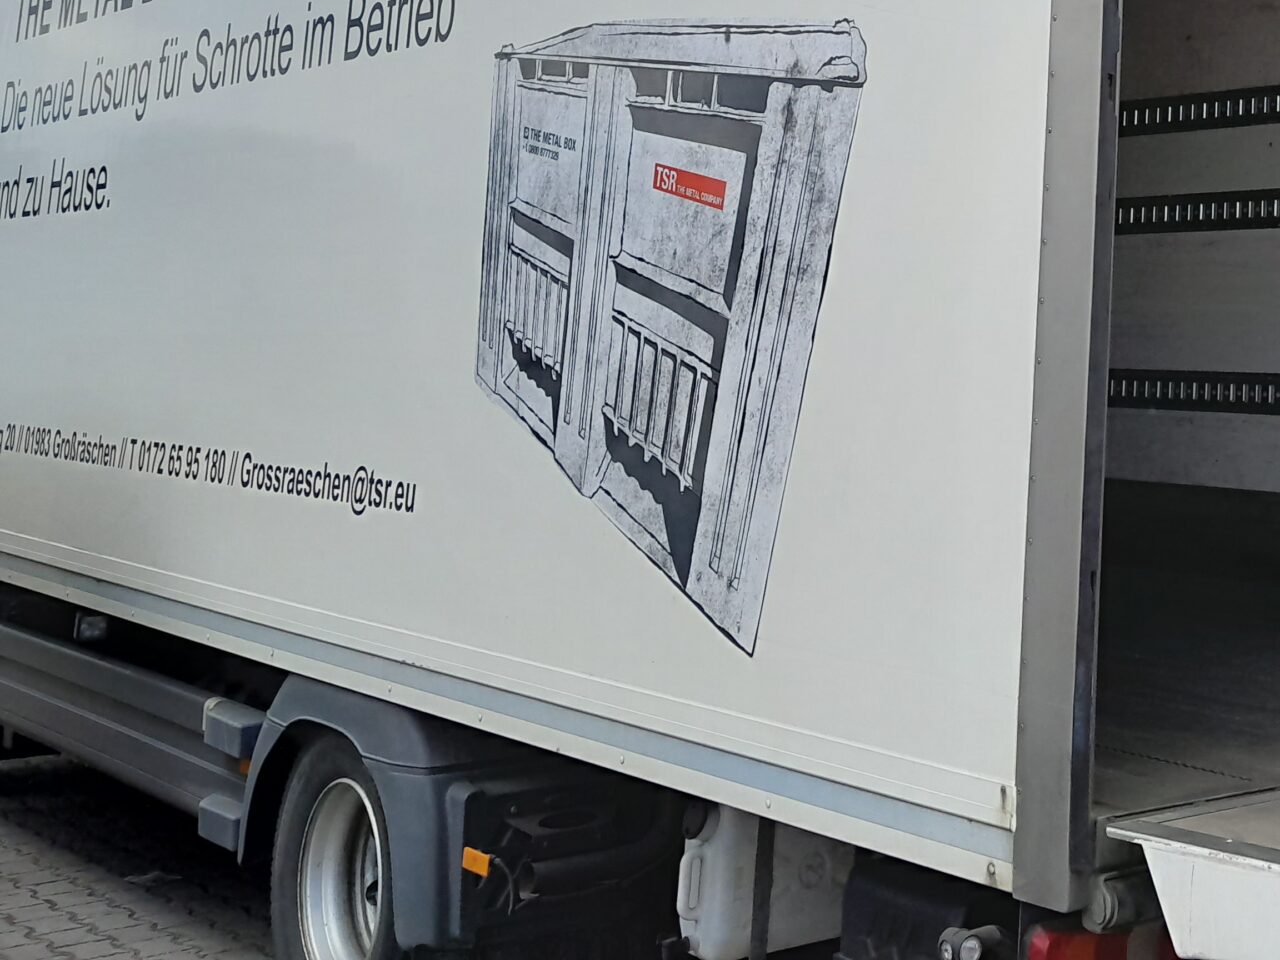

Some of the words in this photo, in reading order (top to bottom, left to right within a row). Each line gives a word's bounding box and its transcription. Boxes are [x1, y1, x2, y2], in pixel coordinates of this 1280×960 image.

[1, 78, 28, 133] Die
[30, 79, 75, 127] neue
[78, 56, 152, 121] Lösung
[156, 36, 188, 101] für
[192, 12, 294, 94] Schrotte
[301, 1, 335, 70] im
[530, 127, 541, 143] THE
[542, 131, 562, 148] METAL
[563, 136, 577, 151] BOX
[0, 164, 22, 219] nd
[22, 175, 44, 217] zu
[47, 157, 110, 214] Hause.
[656, 166, 678, 192] TSR
[677, 184, 686, 196] THE
[686, 187, 700, 199] METAL
[700, 191, 724, 206] COMPANY
[4, 423, 16, 451] 20
[24, 425, 51, 457] 01983
[53, 428, 117, 467] Großräschen
[129, 439, 138, 470] T
[138, 440, 166, 474] 0172
[168, 443, 184, 477] 65
[185, 446, 201, 480] 95
[204, 448, 226, 484] 180
[240, 452, 417, 516] Grossraeschen@tsr.eu
